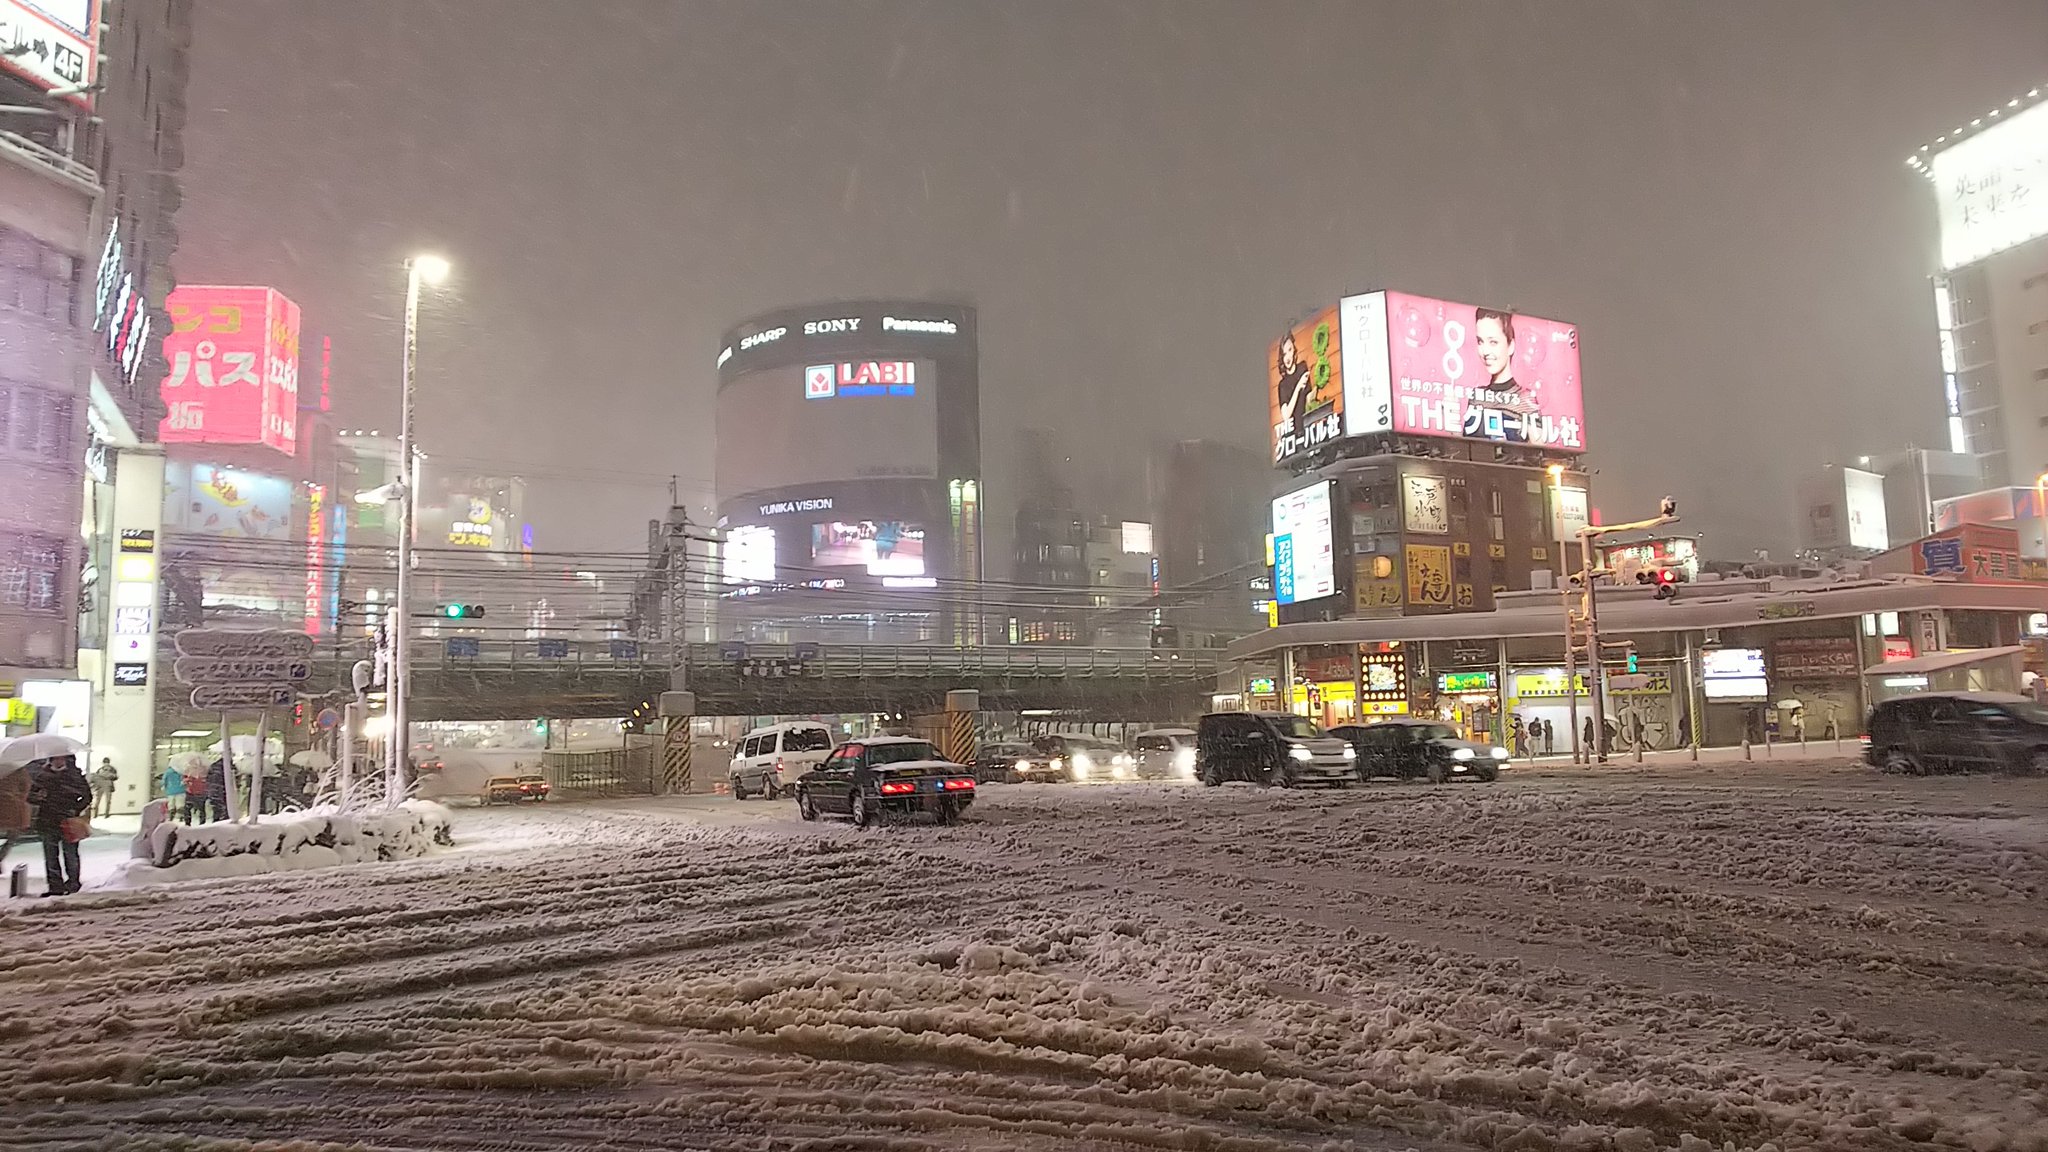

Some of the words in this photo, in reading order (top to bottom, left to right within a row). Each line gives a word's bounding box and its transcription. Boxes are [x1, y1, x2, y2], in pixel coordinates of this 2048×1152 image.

[57, 48, 81, 79] 4F
[741, 328, 786, 349] SHARP
[804, 318, 860, 334] SONY
[883, 317, 957, 334] Panasonic
[167, 341, 260, 387] パス
[837, 362, 915, 385] LABI
[1274, 416, 1295, 438] THE
[1400, 395, 1462, 433] THE
[1462, 404, 1581, 448] グローバル社
[1275, 412, 1341, 461] グローバル社
[759, 504, 794, 516] YUNIKA
[796, 498, 833, 512] VISION
[1919, 536, 1967, 576] 質
